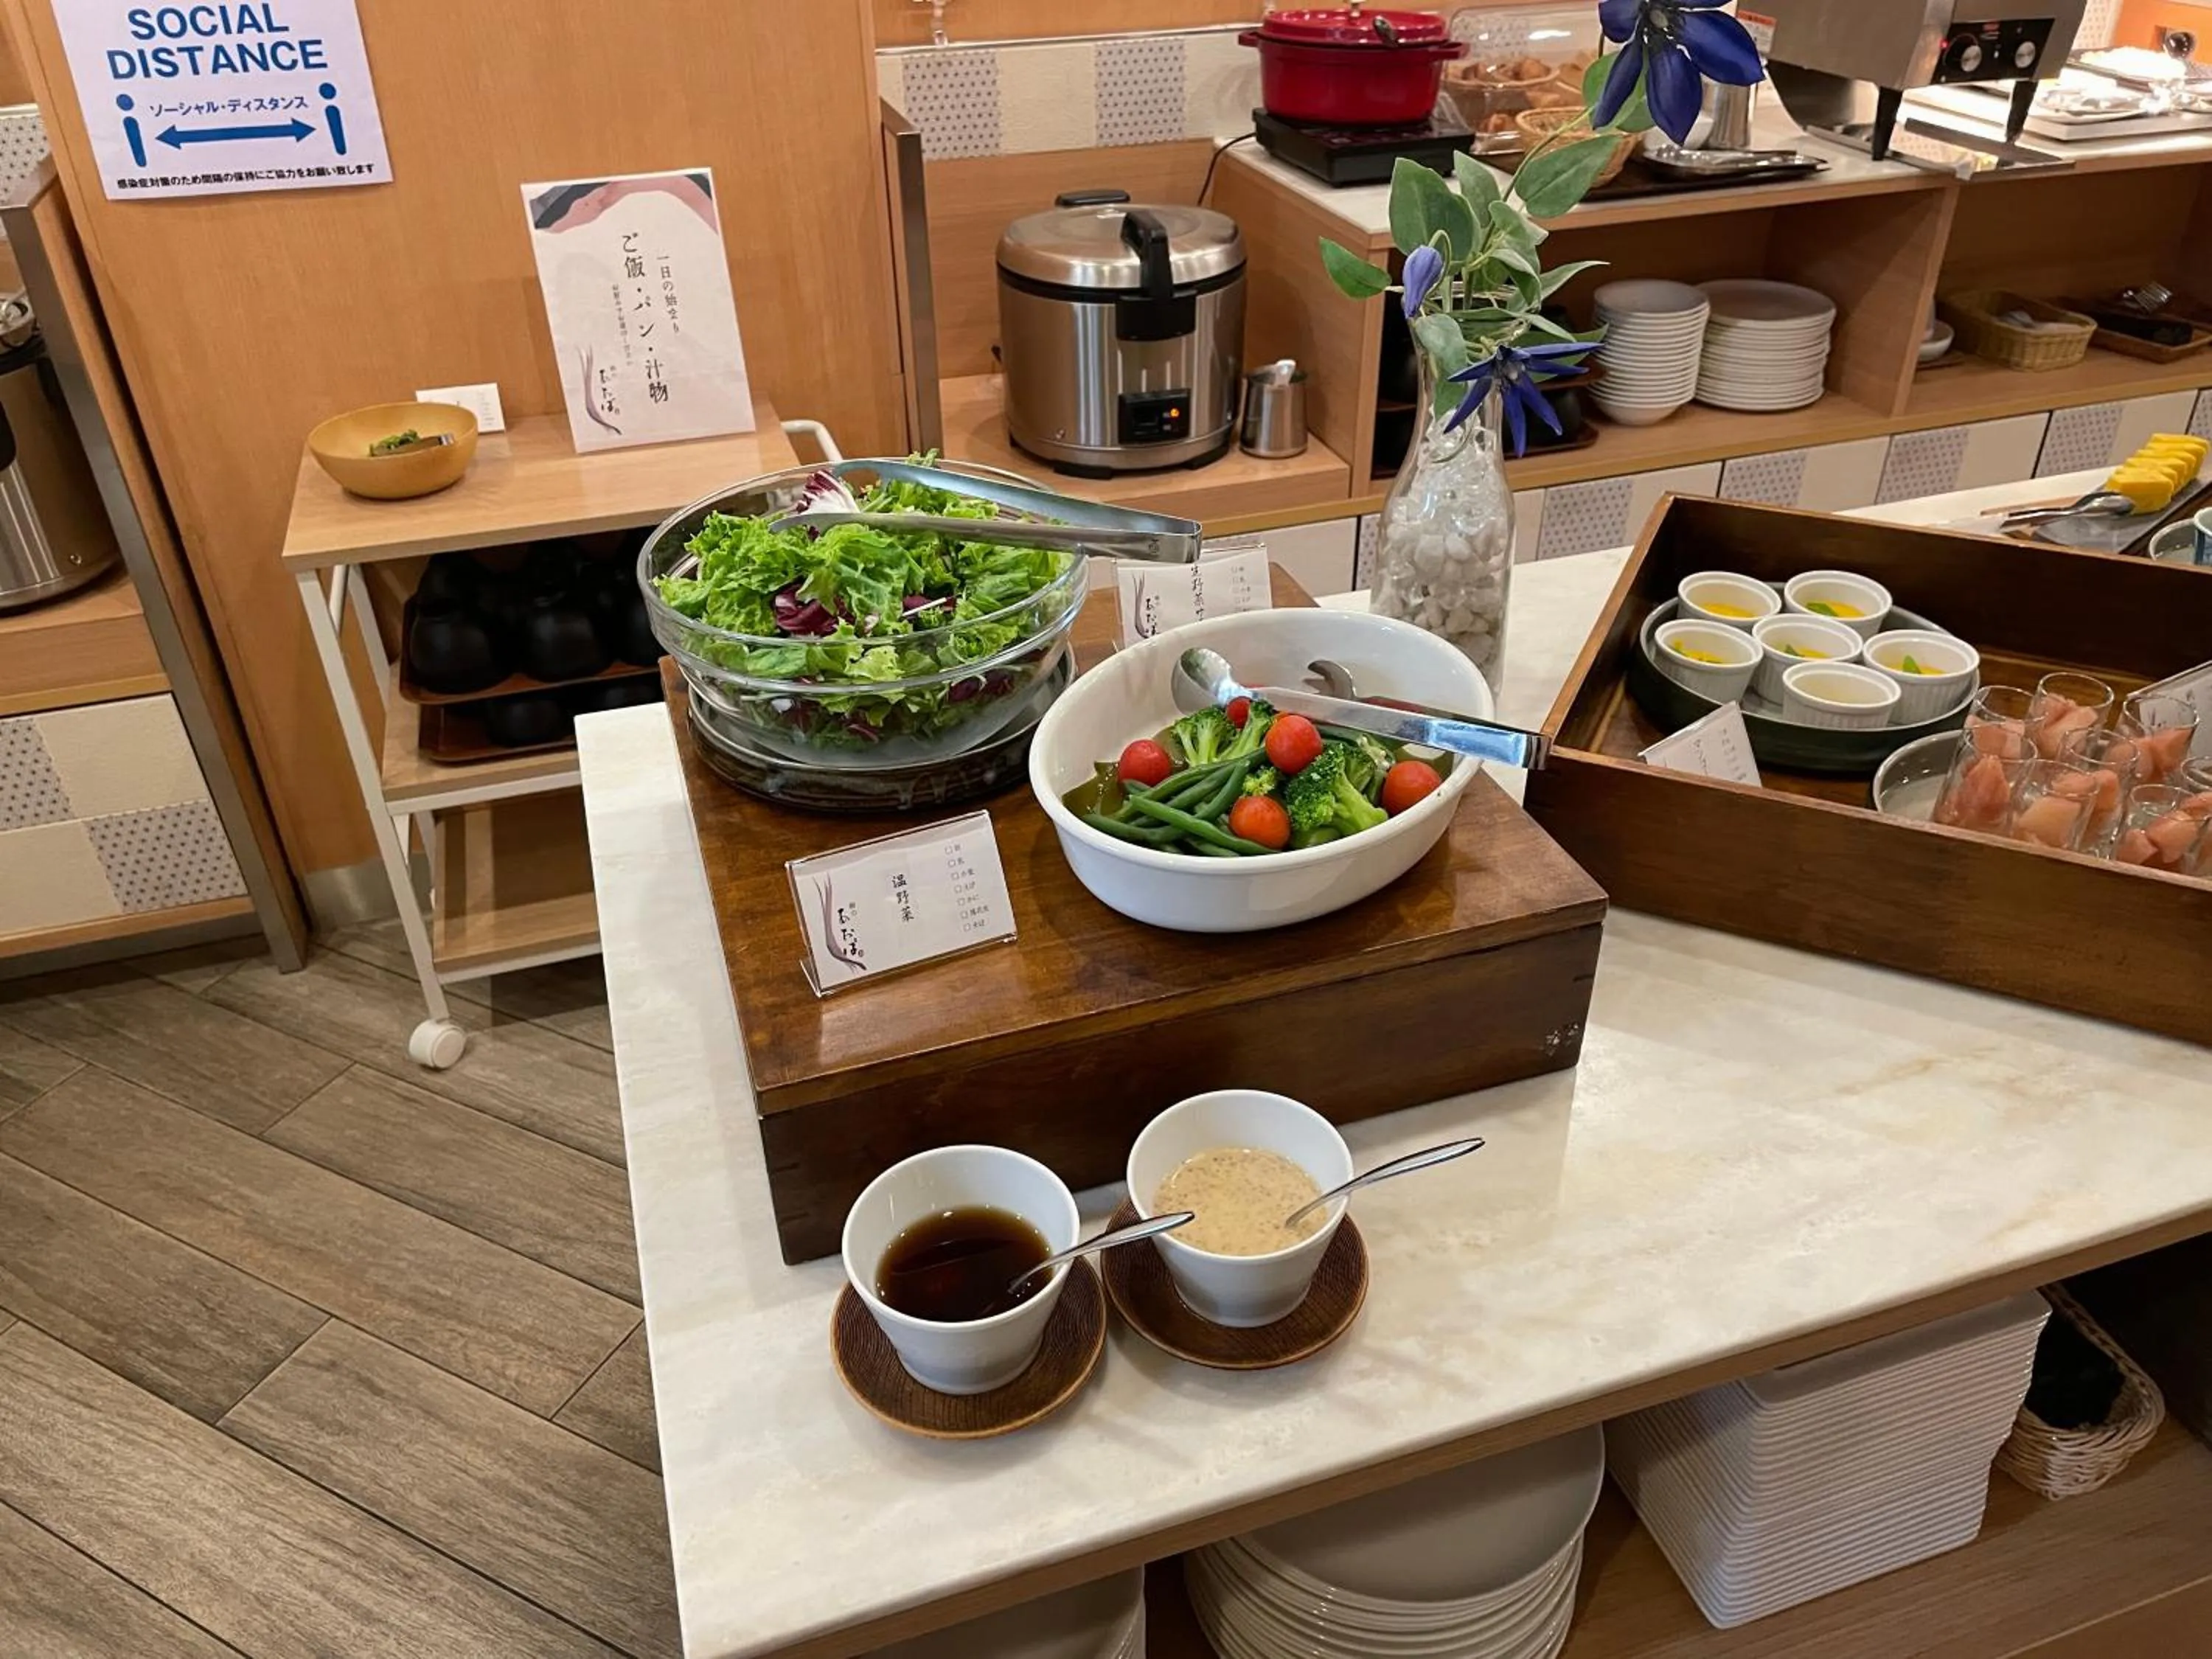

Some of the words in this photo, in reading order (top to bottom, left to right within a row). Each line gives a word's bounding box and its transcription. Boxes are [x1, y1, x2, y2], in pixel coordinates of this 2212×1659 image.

[128, 3, 290, 41] SOCIAL
[107, 39, 328, 79] DISTANCE
[149, 96, 309, 117] ソーシャル・ディスタンス
[891, 873, 914, 922] 温野菜
